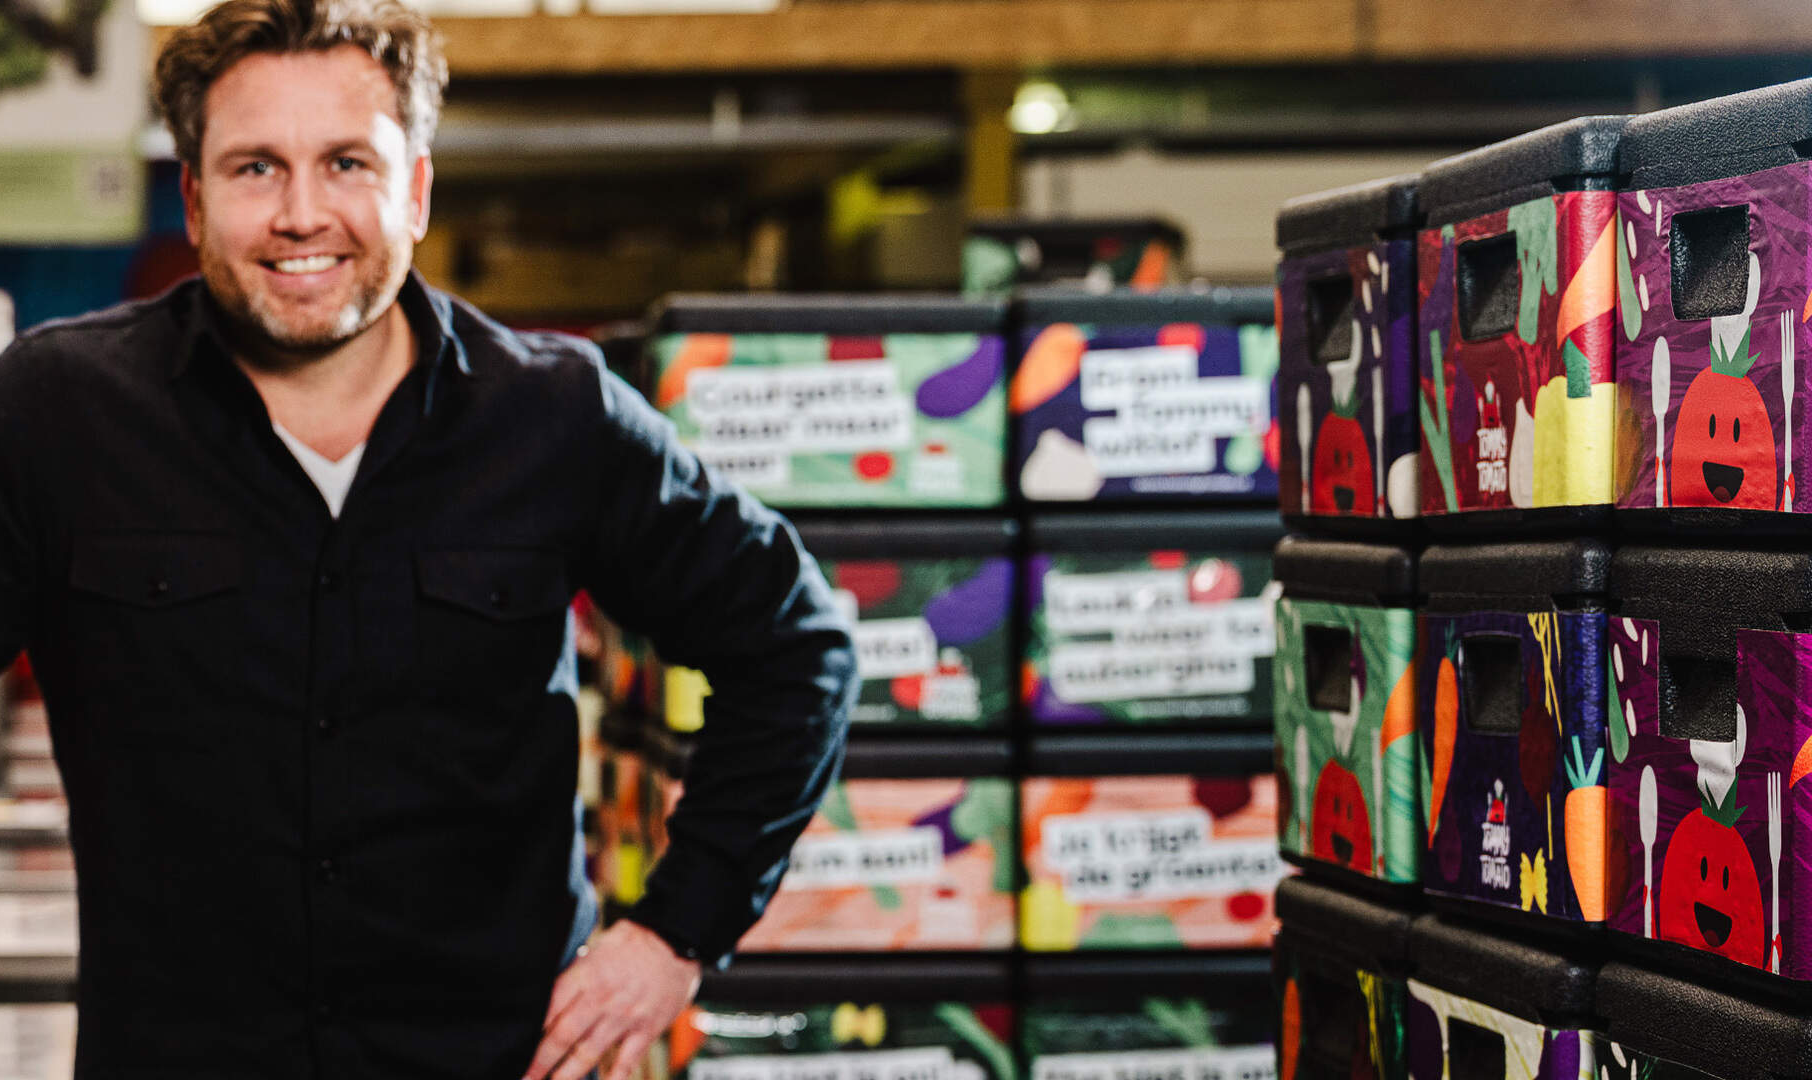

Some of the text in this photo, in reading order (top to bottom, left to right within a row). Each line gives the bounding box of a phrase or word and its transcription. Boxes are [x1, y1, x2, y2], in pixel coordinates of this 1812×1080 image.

[1476, 426, 1508, 461] TOMMY
[1476, 459, 1508, 495] TOMATO
[1481, 821, 1511, 857] TOMMY
[1479, 854, 1511, 890] TOMATO
